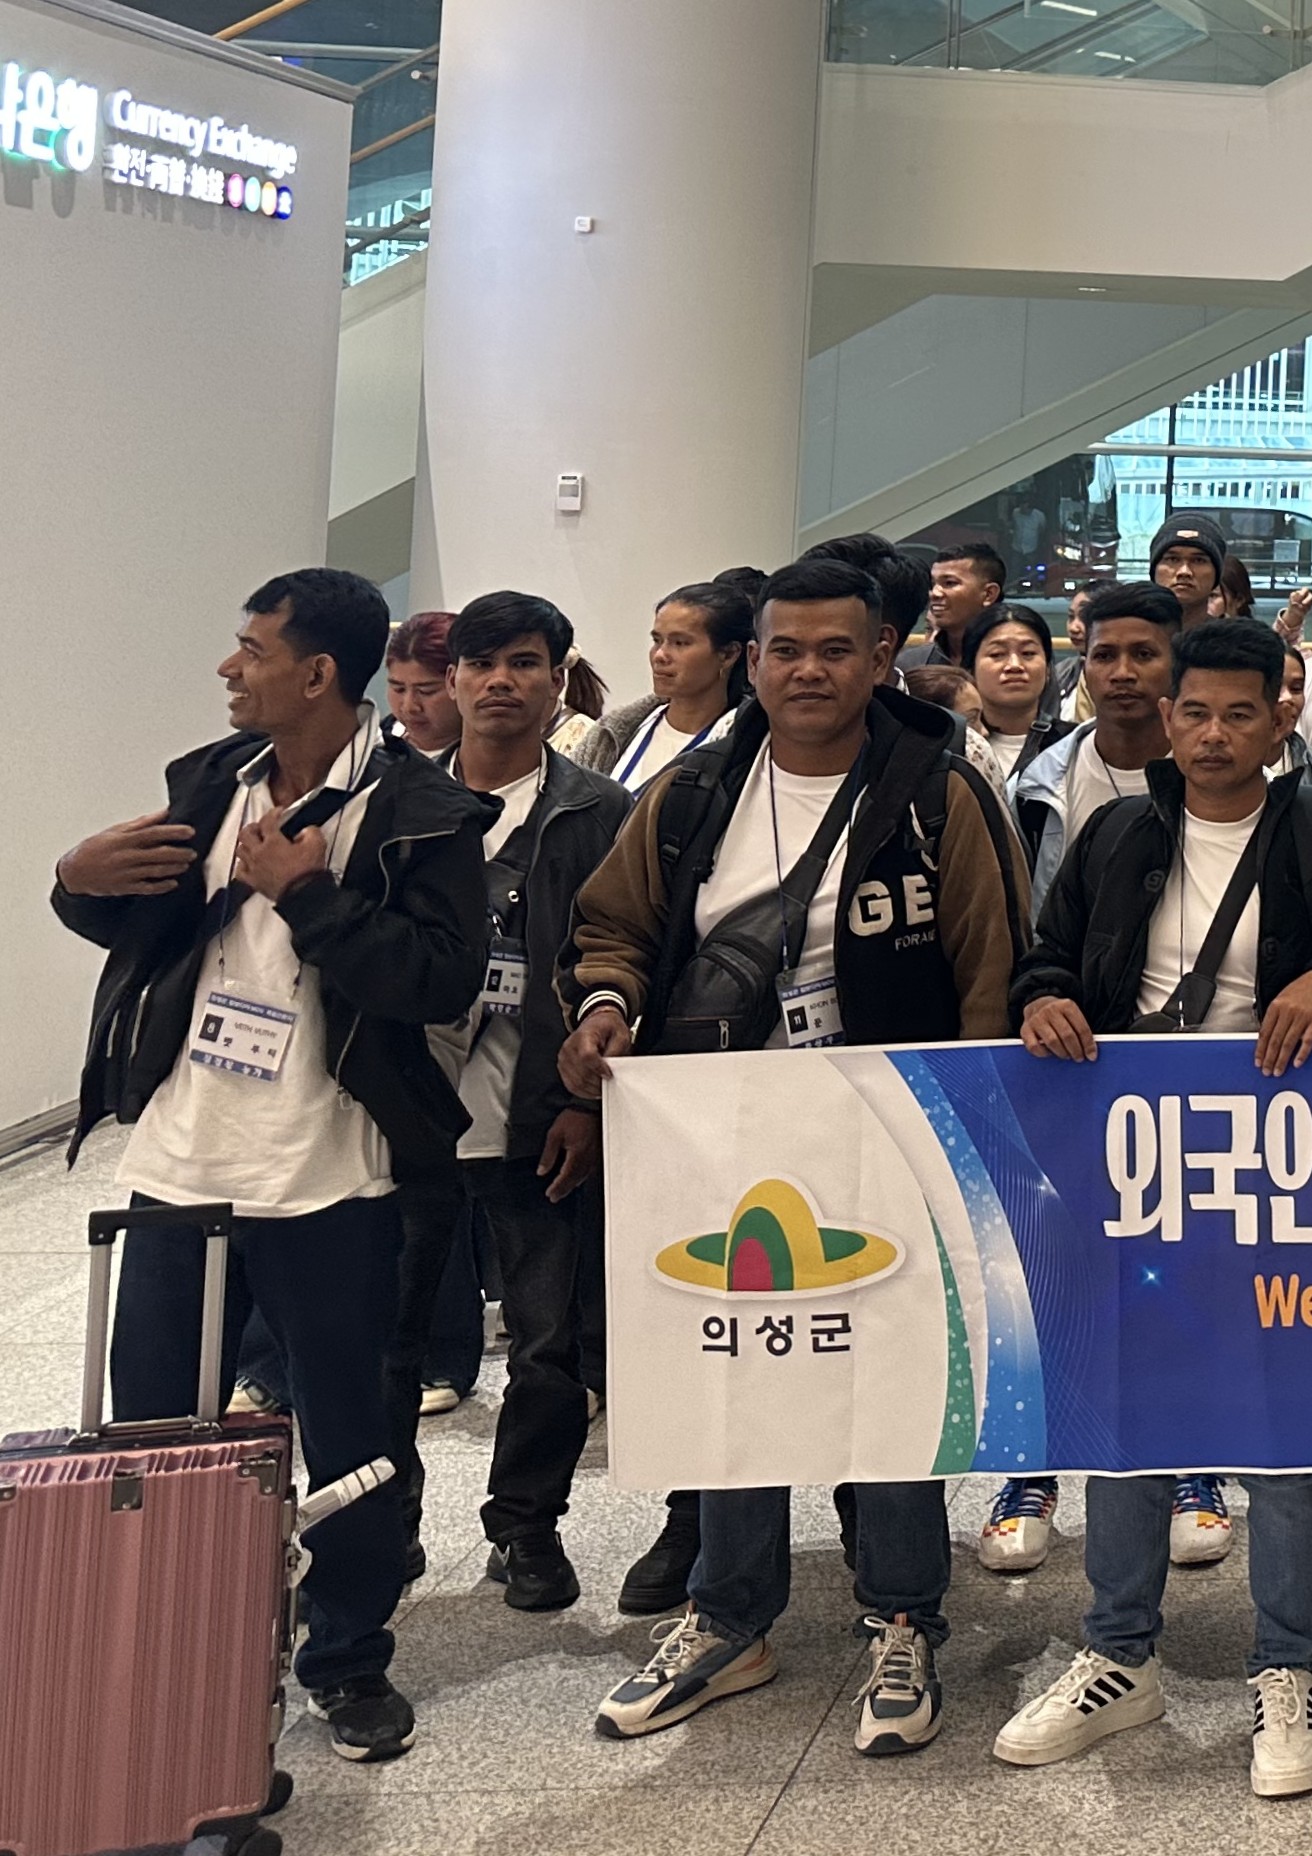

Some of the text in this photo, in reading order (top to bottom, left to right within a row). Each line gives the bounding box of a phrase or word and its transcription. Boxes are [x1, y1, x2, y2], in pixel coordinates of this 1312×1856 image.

[112, 90, 298, 178] Currency Exchange
[701, 1312, 853, 1358] 의성군
